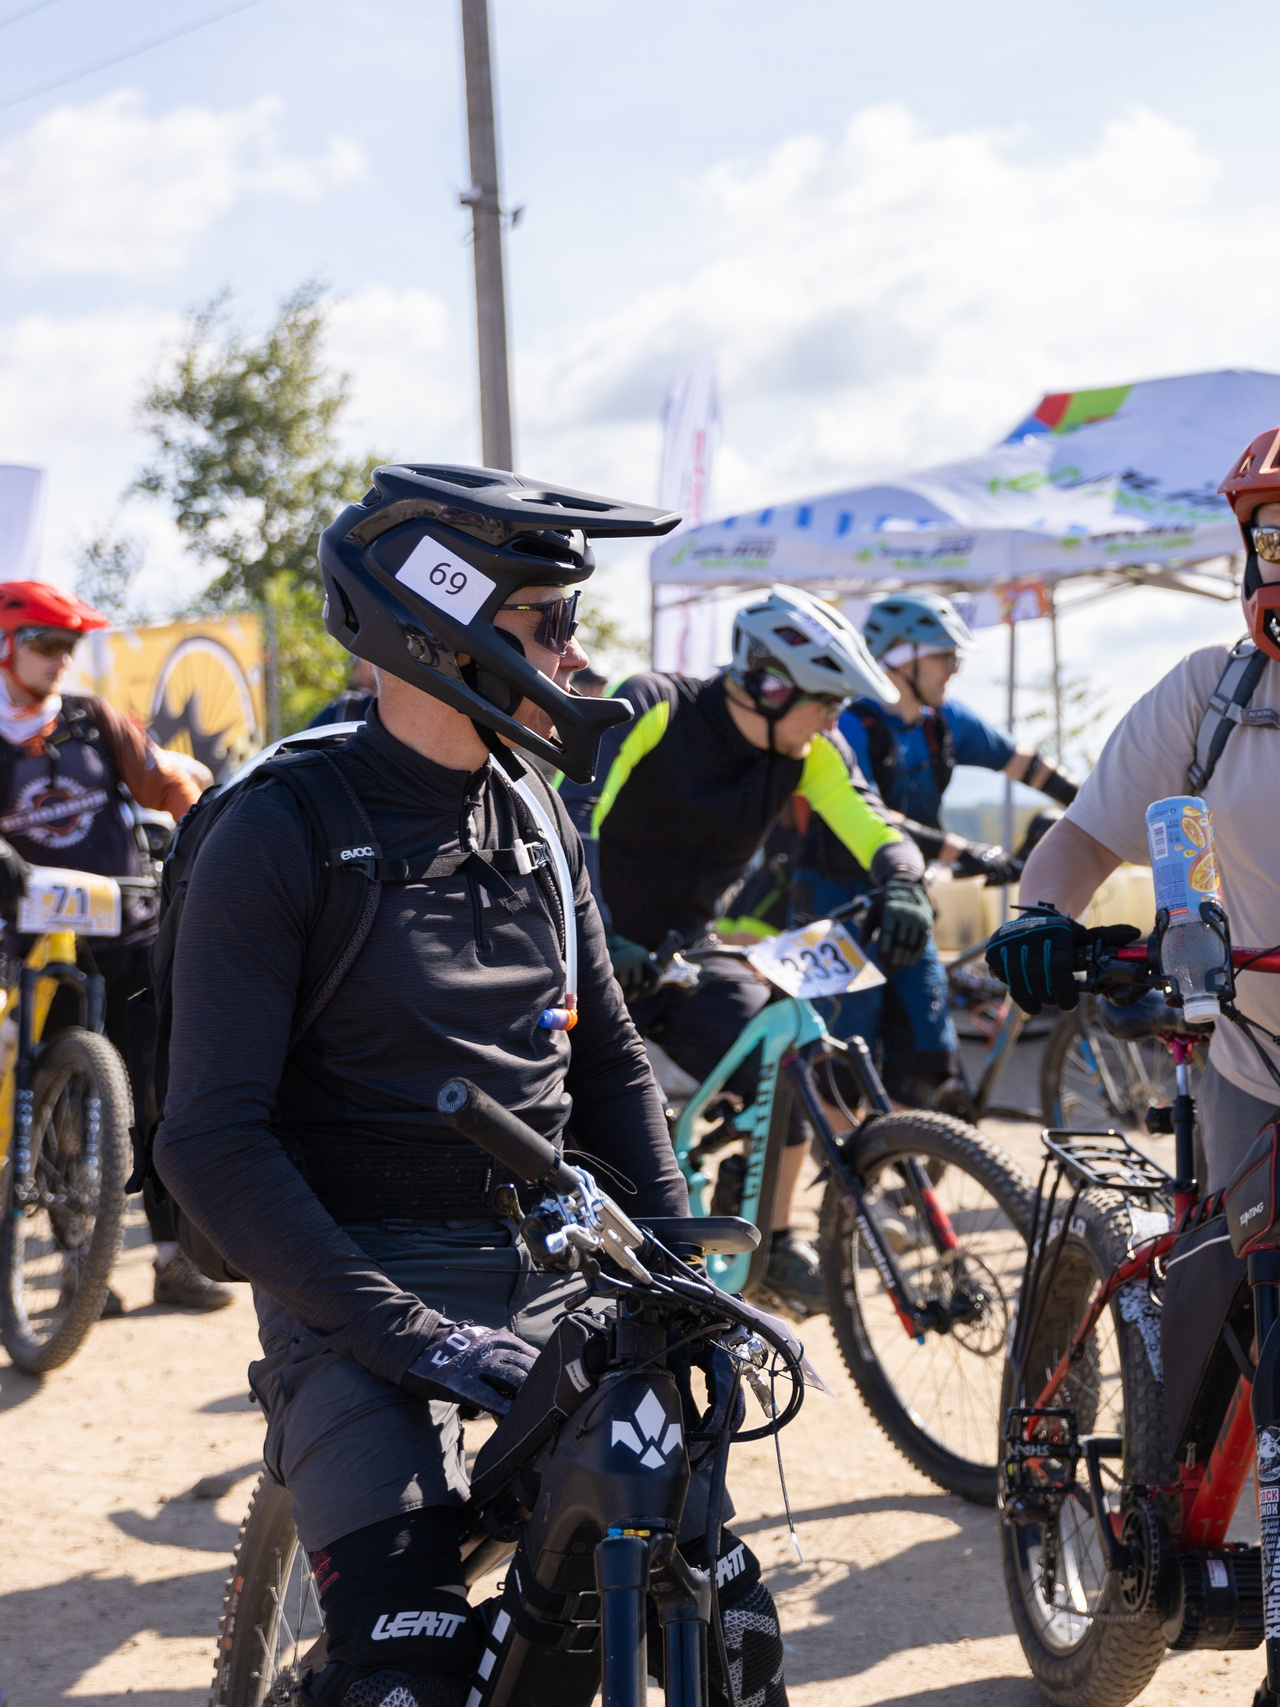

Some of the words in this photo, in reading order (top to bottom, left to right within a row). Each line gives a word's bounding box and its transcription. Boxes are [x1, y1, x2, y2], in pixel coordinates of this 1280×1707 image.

[429, 562, 468, 596] 69
[53, 886, 88, 914] 71
[371, 1610, 466, 1641] LEATT
